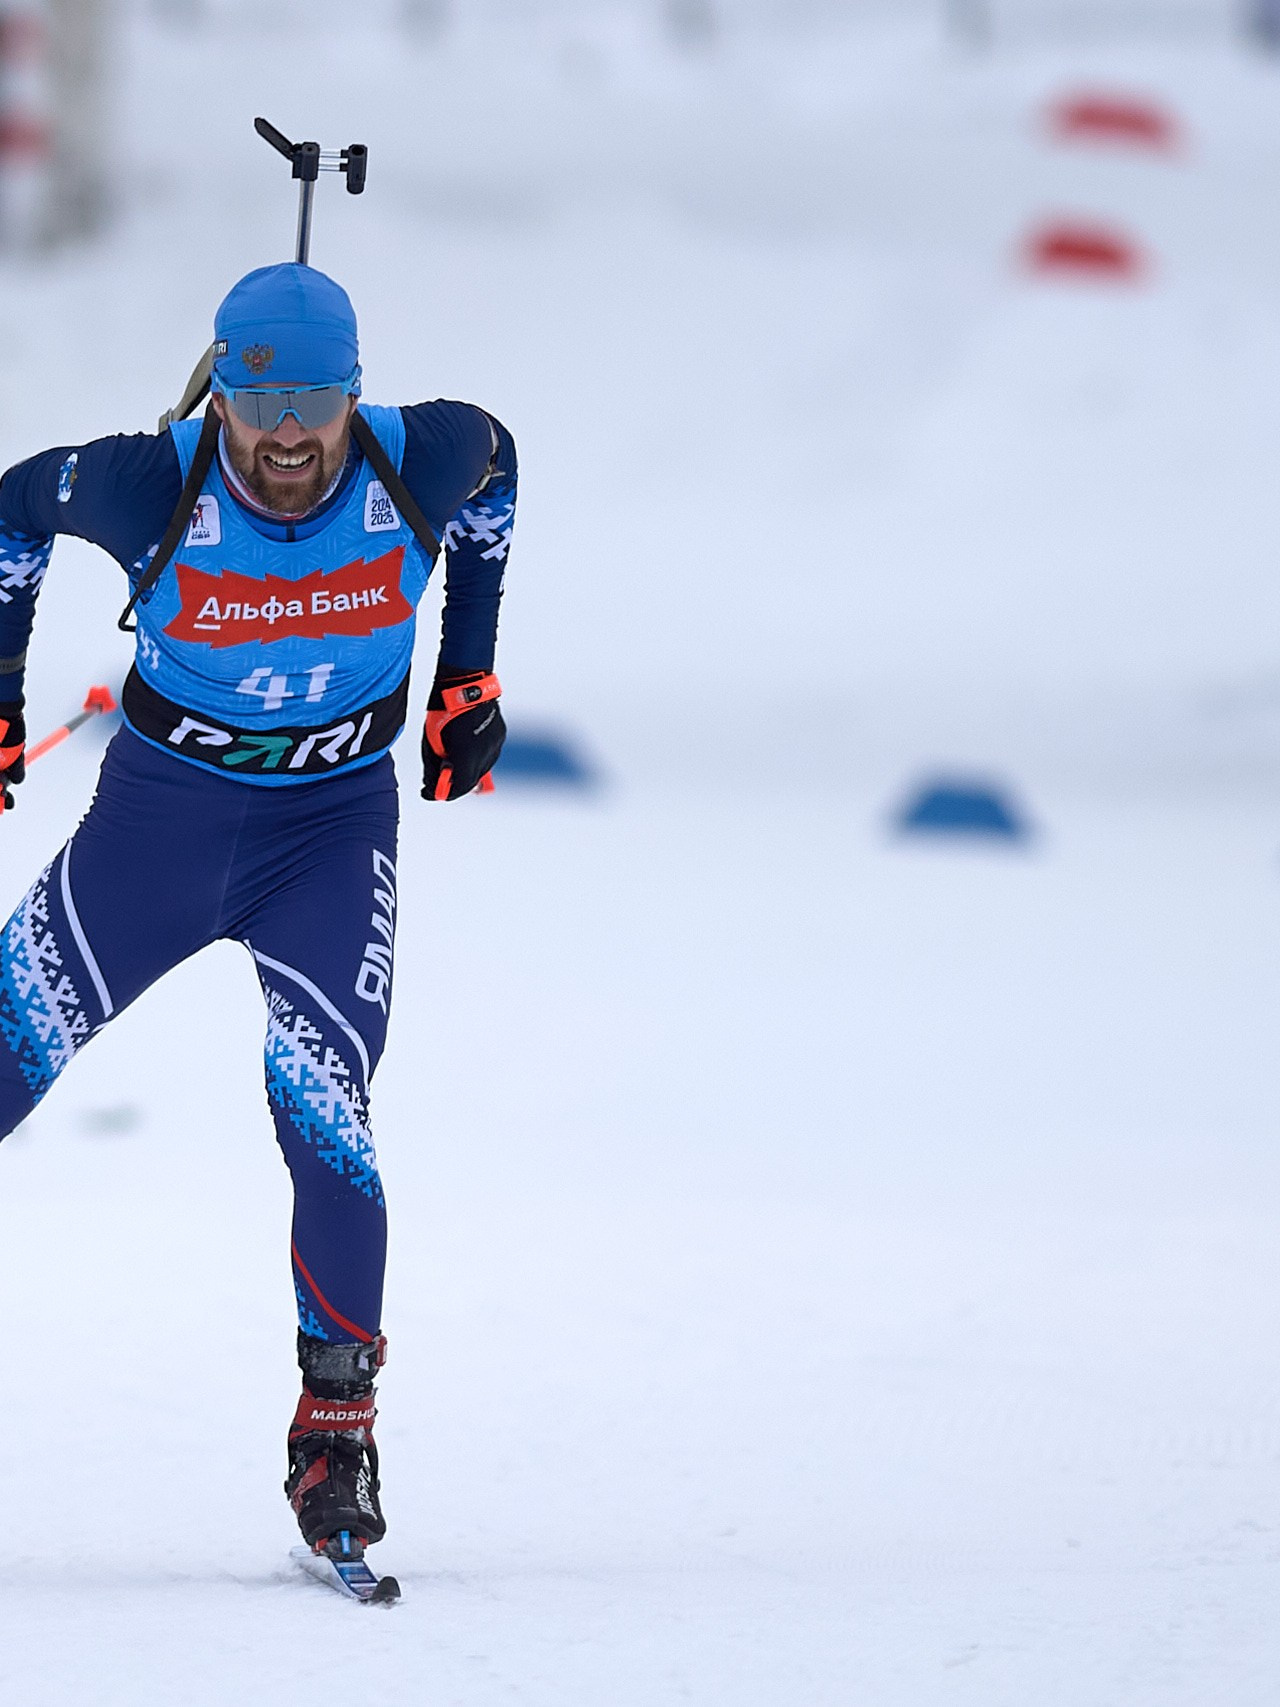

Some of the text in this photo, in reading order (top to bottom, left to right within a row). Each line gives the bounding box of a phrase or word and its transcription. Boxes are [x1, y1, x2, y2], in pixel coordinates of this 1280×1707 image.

[370, 511, 394, 526] 2025
[196, 585, 389, 625] Альфа Банк
[235, 663, 335, 710] 41
[168, 712, 373, 768] PARI
